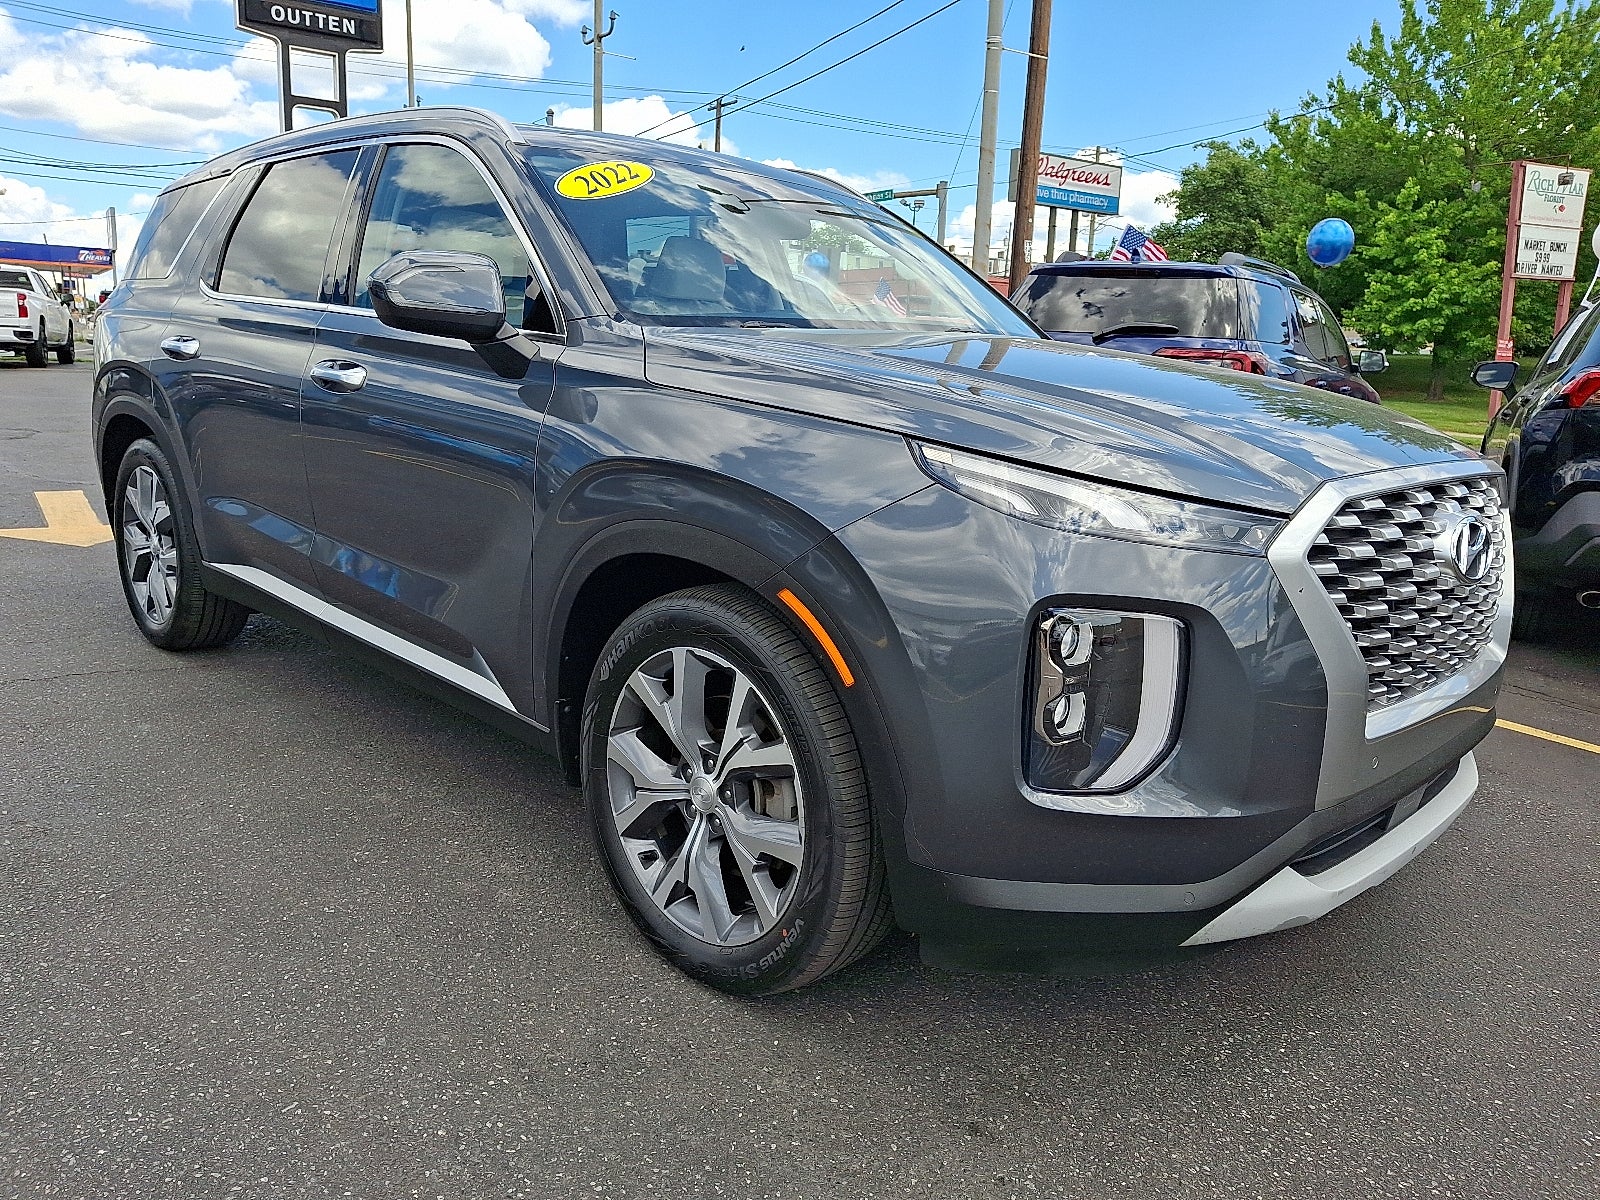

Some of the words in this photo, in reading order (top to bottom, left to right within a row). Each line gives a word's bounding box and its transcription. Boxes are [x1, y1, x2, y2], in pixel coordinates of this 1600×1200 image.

[270, 5, 356, 35] OUTTEN
[574, 163, 641, 195] 2022
[1038, 156, 1111, 186] Walgreens
[1036, 187, 1050, 198] ive
[1051, 189, 1068, 201] thru
[1069, 192, 1109, 209] pharmacy
[1544, 194, 1565, 204] FLORIST
[1524, 239, 1547, 252] MARKET
[1549, 241, 1568, 253] BUNCH
[79, 250, 89, 261] 7
[1516, 262, 1538, 274] DRIVER
[1540, 265, 1564, 276] WANTED
